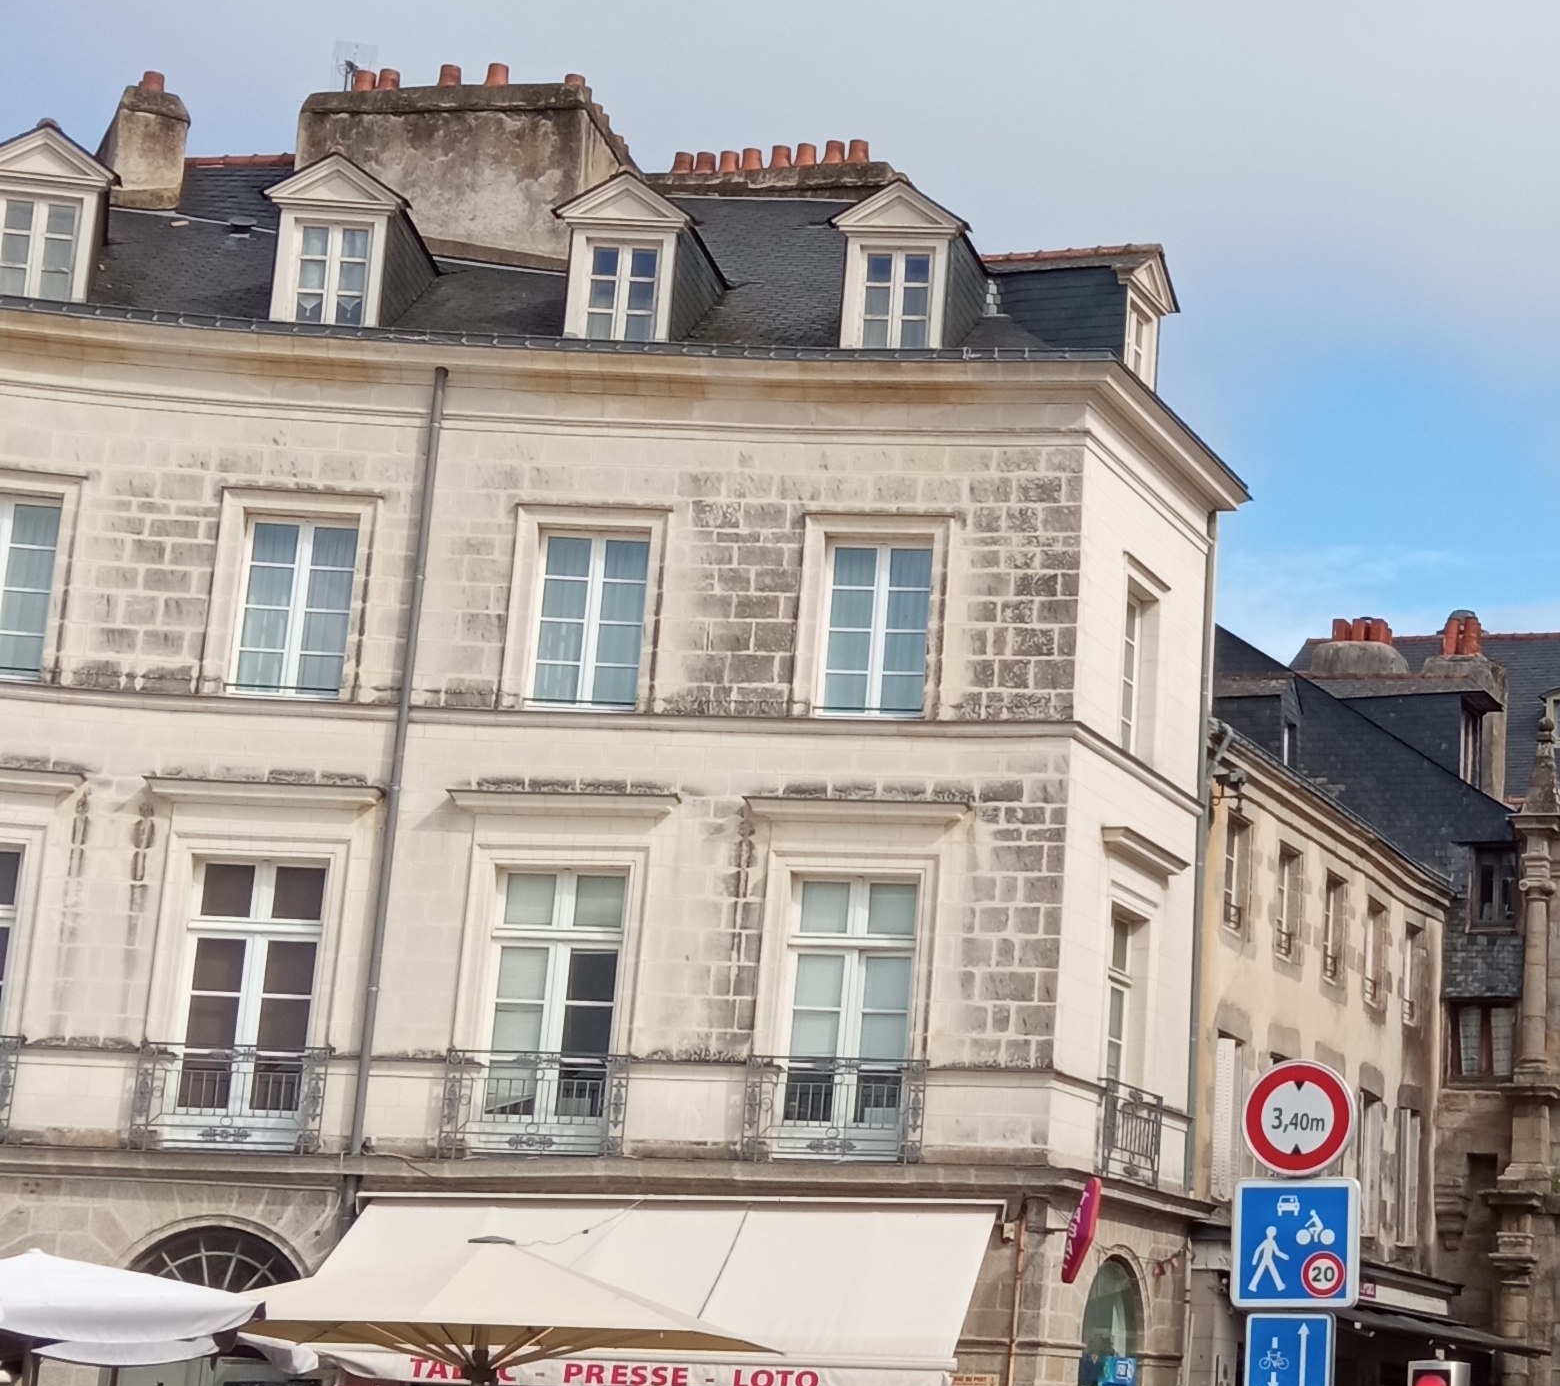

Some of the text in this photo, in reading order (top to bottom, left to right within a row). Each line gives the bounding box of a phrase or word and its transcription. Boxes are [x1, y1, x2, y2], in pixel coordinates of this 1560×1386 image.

[1271, 1107, 1325, 1133] 3,40m
[1311, 1266, 1335, 1282] 20
[410, 1357, 516, 1382] TAC
[563, 1363, 689, 1386] PRESSE
